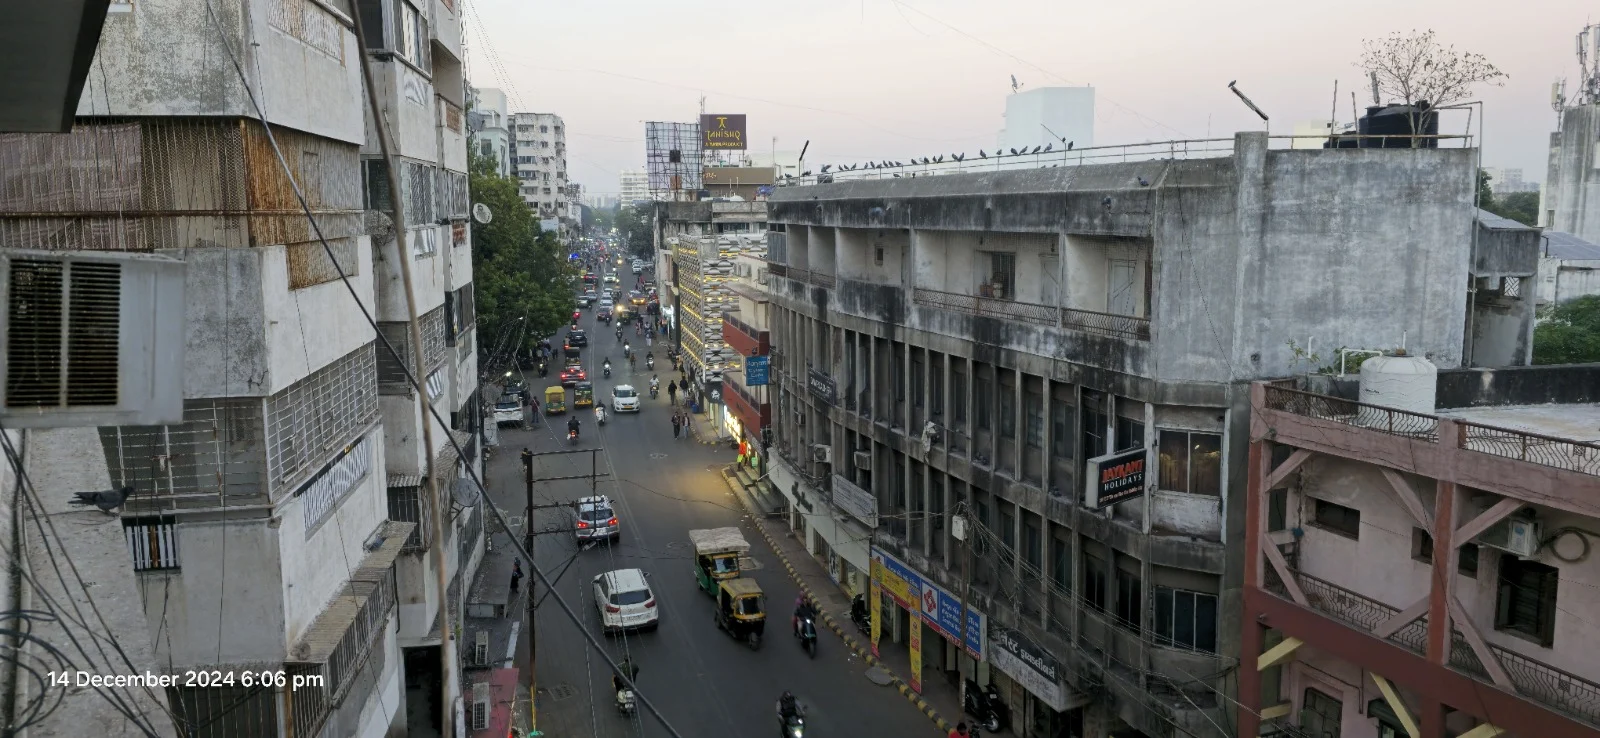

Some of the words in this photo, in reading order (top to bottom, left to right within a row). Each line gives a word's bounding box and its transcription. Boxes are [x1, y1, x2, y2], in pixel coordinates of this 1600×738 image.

[705, 129, 740, 141] TANISHQ
[1102, 459, 1144, 483] JAYKANT
[1104, 473, 1142, 491] HOLIDAYS
